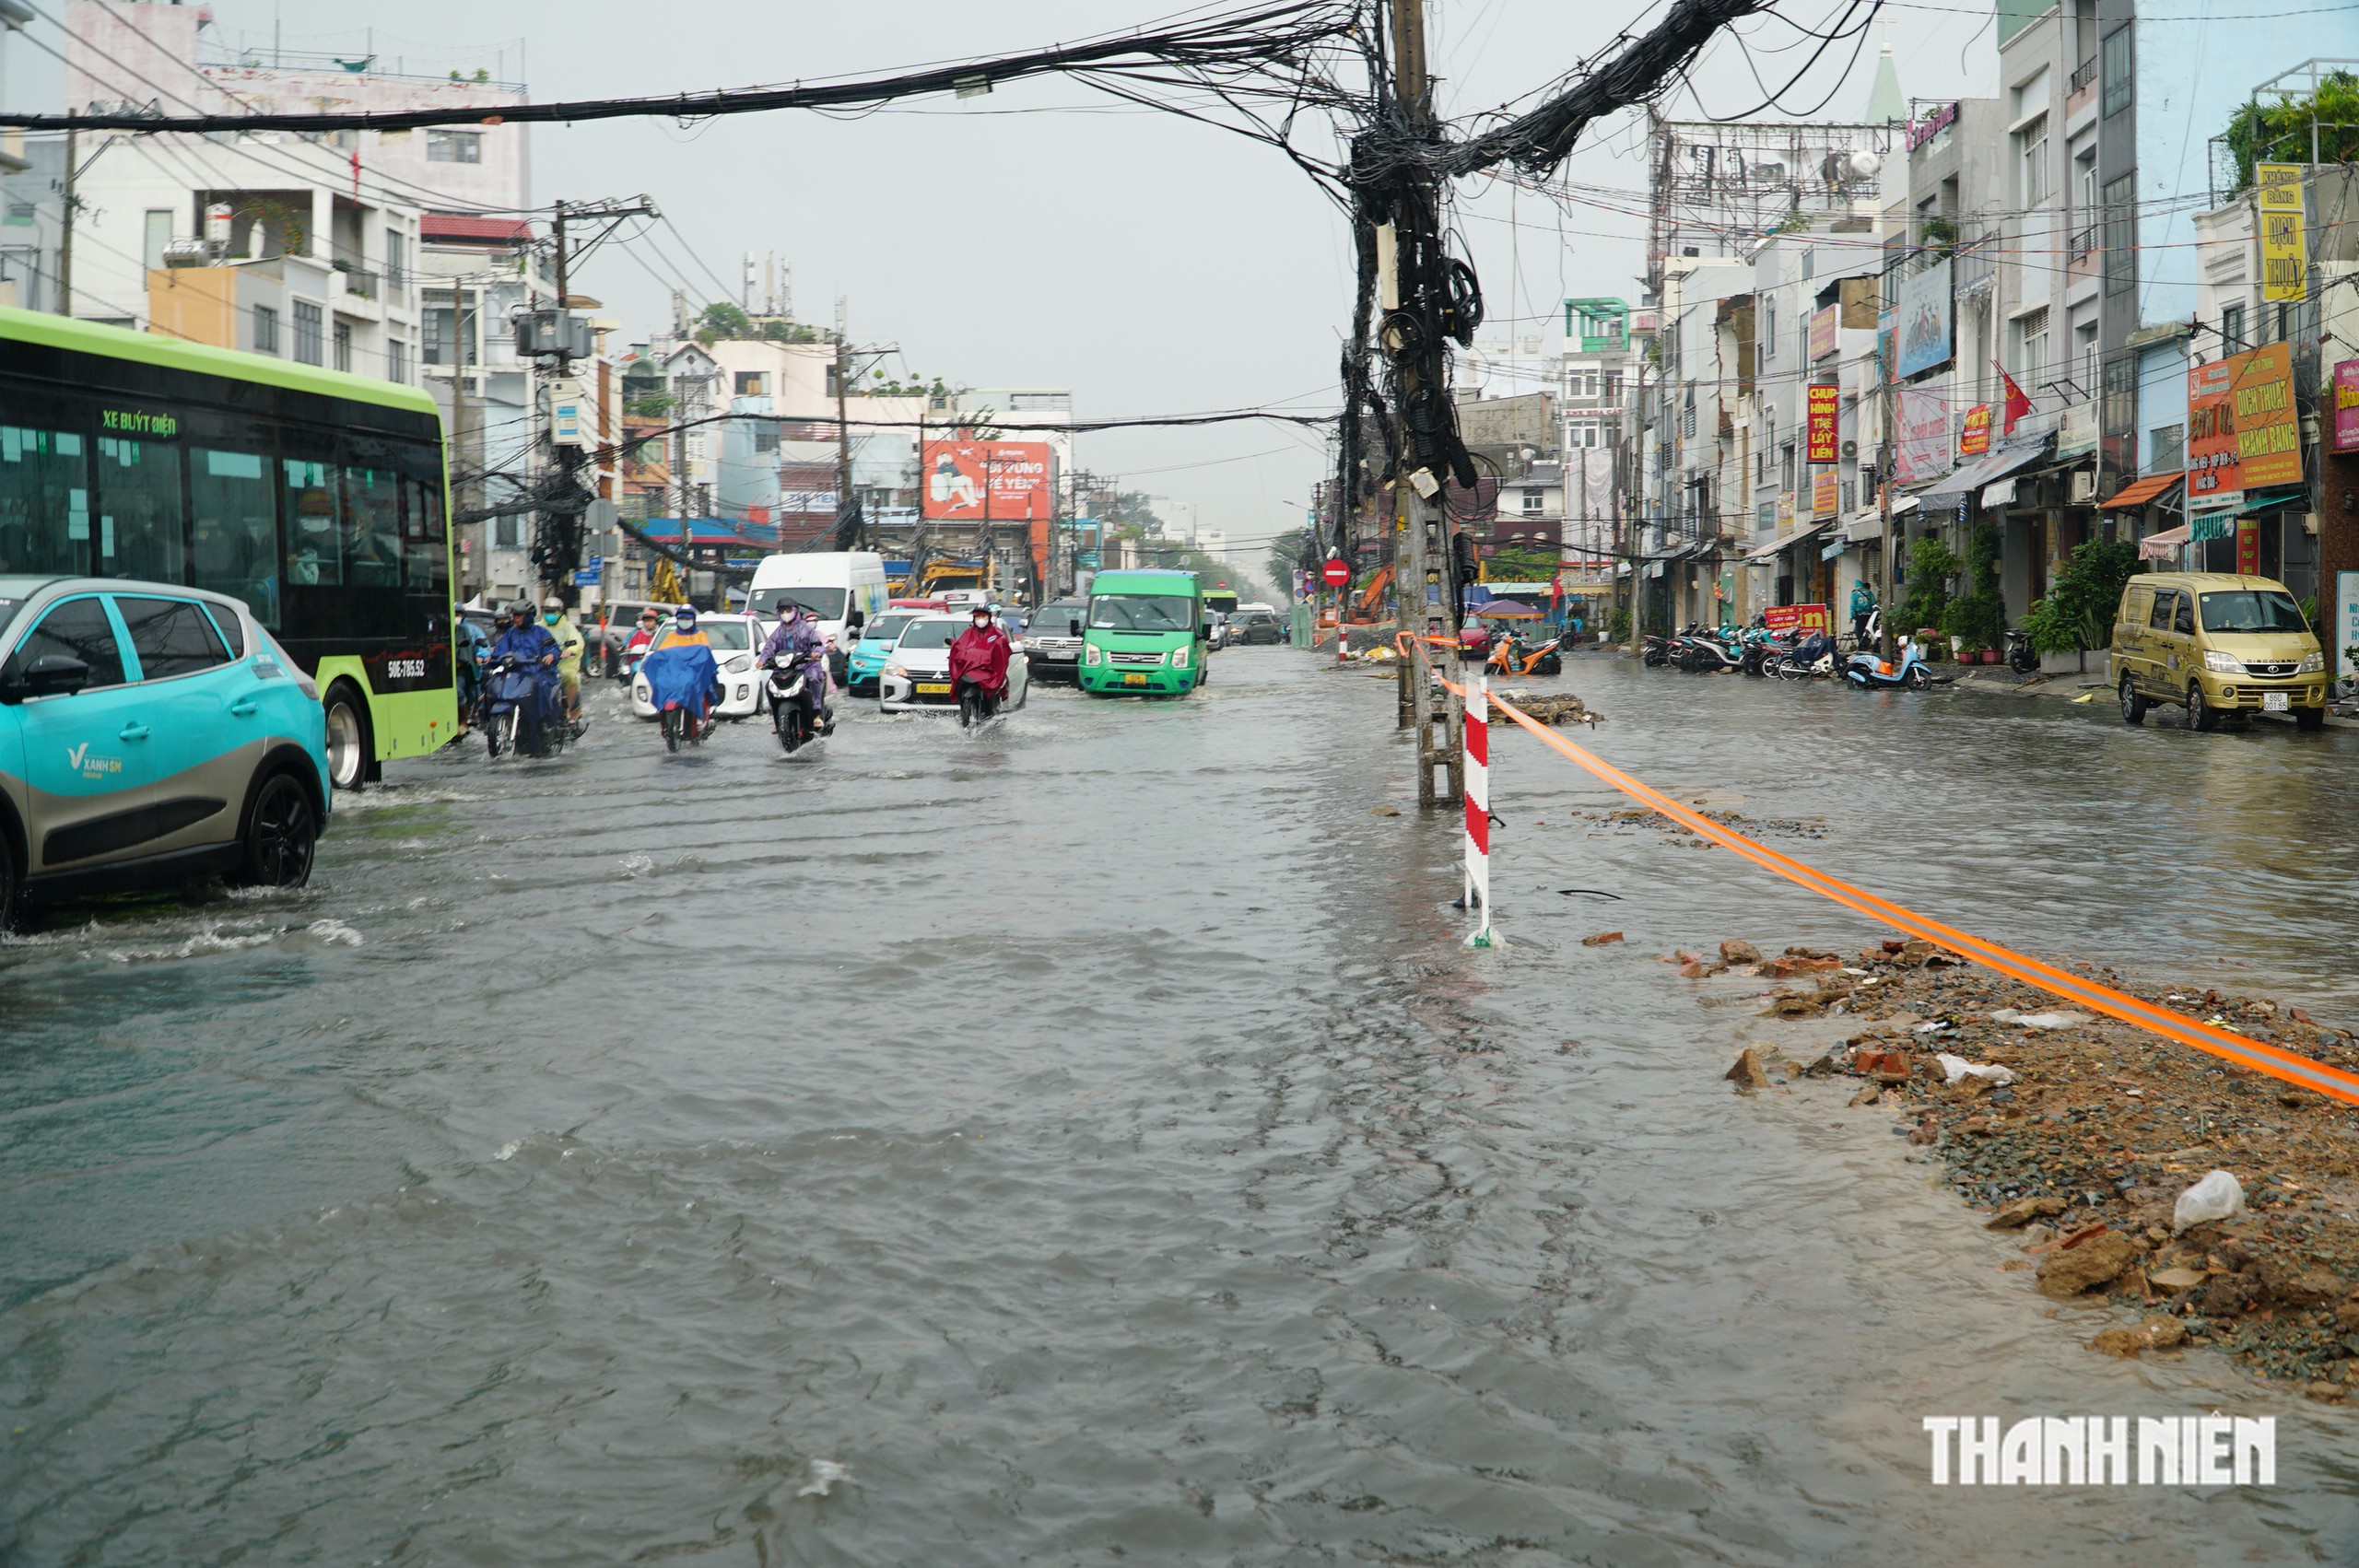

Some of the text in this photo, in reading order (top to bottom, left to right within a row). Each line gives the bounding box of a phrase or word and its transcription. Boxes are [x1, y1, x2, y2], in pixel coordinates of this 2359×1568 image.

[2262, 169, 2295, 184] KHÁNH
[2268, 216, 2296, 251] DỊCH
[2266, 253, 2302, 293] THUẬT
[1809, 388, 1837, 402] CHỤP
[2236, 387, 2259, 422] DỊCH
[2258, 375, 2287, 415] THUẬT
[1810, 400, 1836, 415] HÌNH
[102, 409, 176, 438] XE BUÝT ĐIỆN
[1813, 415, 1833, 429] THẺ
[1812, 428, 1833, 444] LẤY
[2238, 424, 2270, 459] KHÁNH
[1811, 445, 1834, 459] LIỀN
[84, 758, 123, 773] XANH SM
